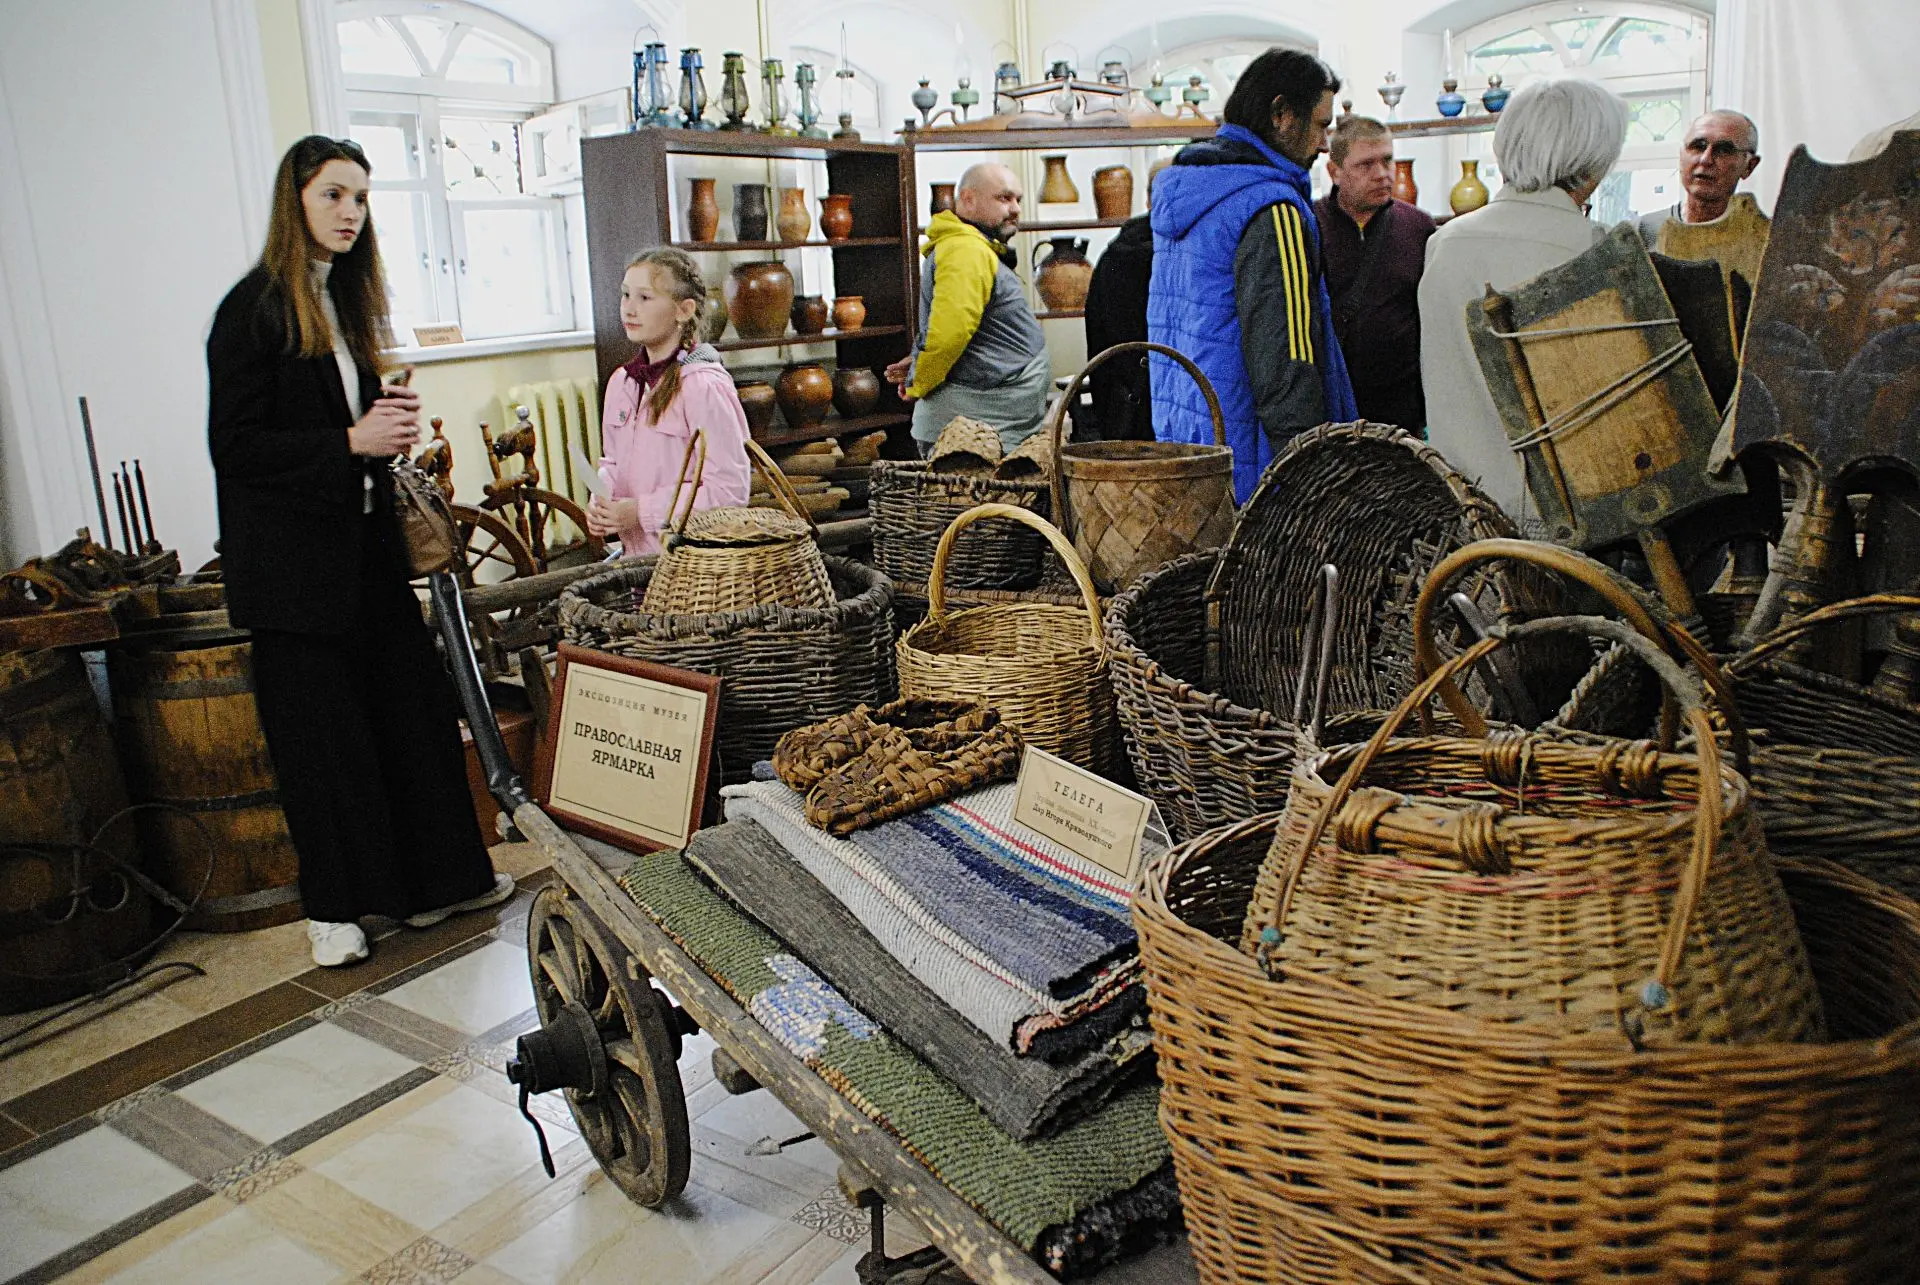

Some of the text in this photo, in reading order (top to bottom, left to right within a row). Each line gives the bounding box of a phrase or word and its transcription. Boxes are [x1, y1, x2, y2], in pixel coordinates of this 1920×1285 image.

[578, 688, 688, 722] ЭКСПОЗИЦИЯ МУЗЕЯ
[574, 722, 682, 763] ПРАВОСЛАВНАЯ
[591, 749, 655, 779] ЯРМАРКА
[1032, 803, 1045, 816] Дар
[1054, 781, 1104, 814] ТЕЛЕГА
